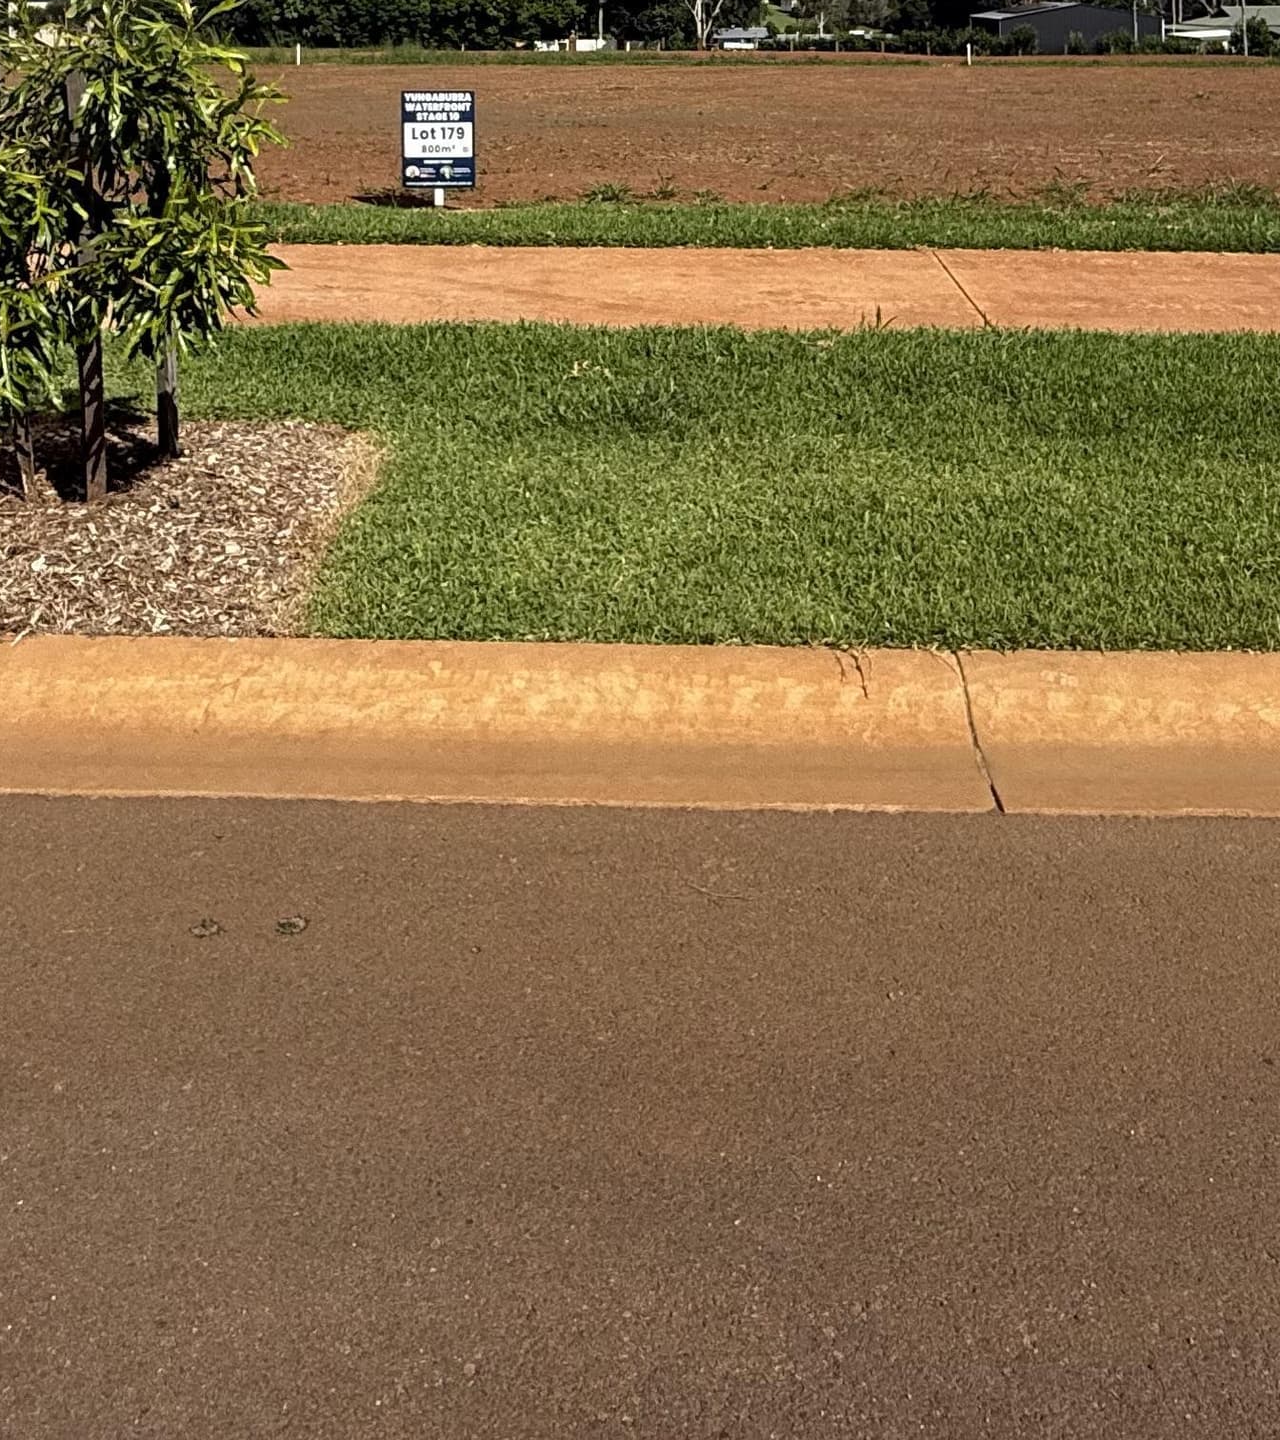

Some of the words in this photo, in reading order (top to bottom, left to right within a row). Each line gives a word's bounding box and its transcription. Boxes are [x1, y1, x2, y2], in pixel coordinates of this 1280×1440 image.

[405, 102, 472, 112] WATERFRONT
[416, 112, 448, 121] STAGE
[449, 112, 460, 121] 10
[412, 127, 437, 140] Lot
[440, 127, 465, 140] 179
